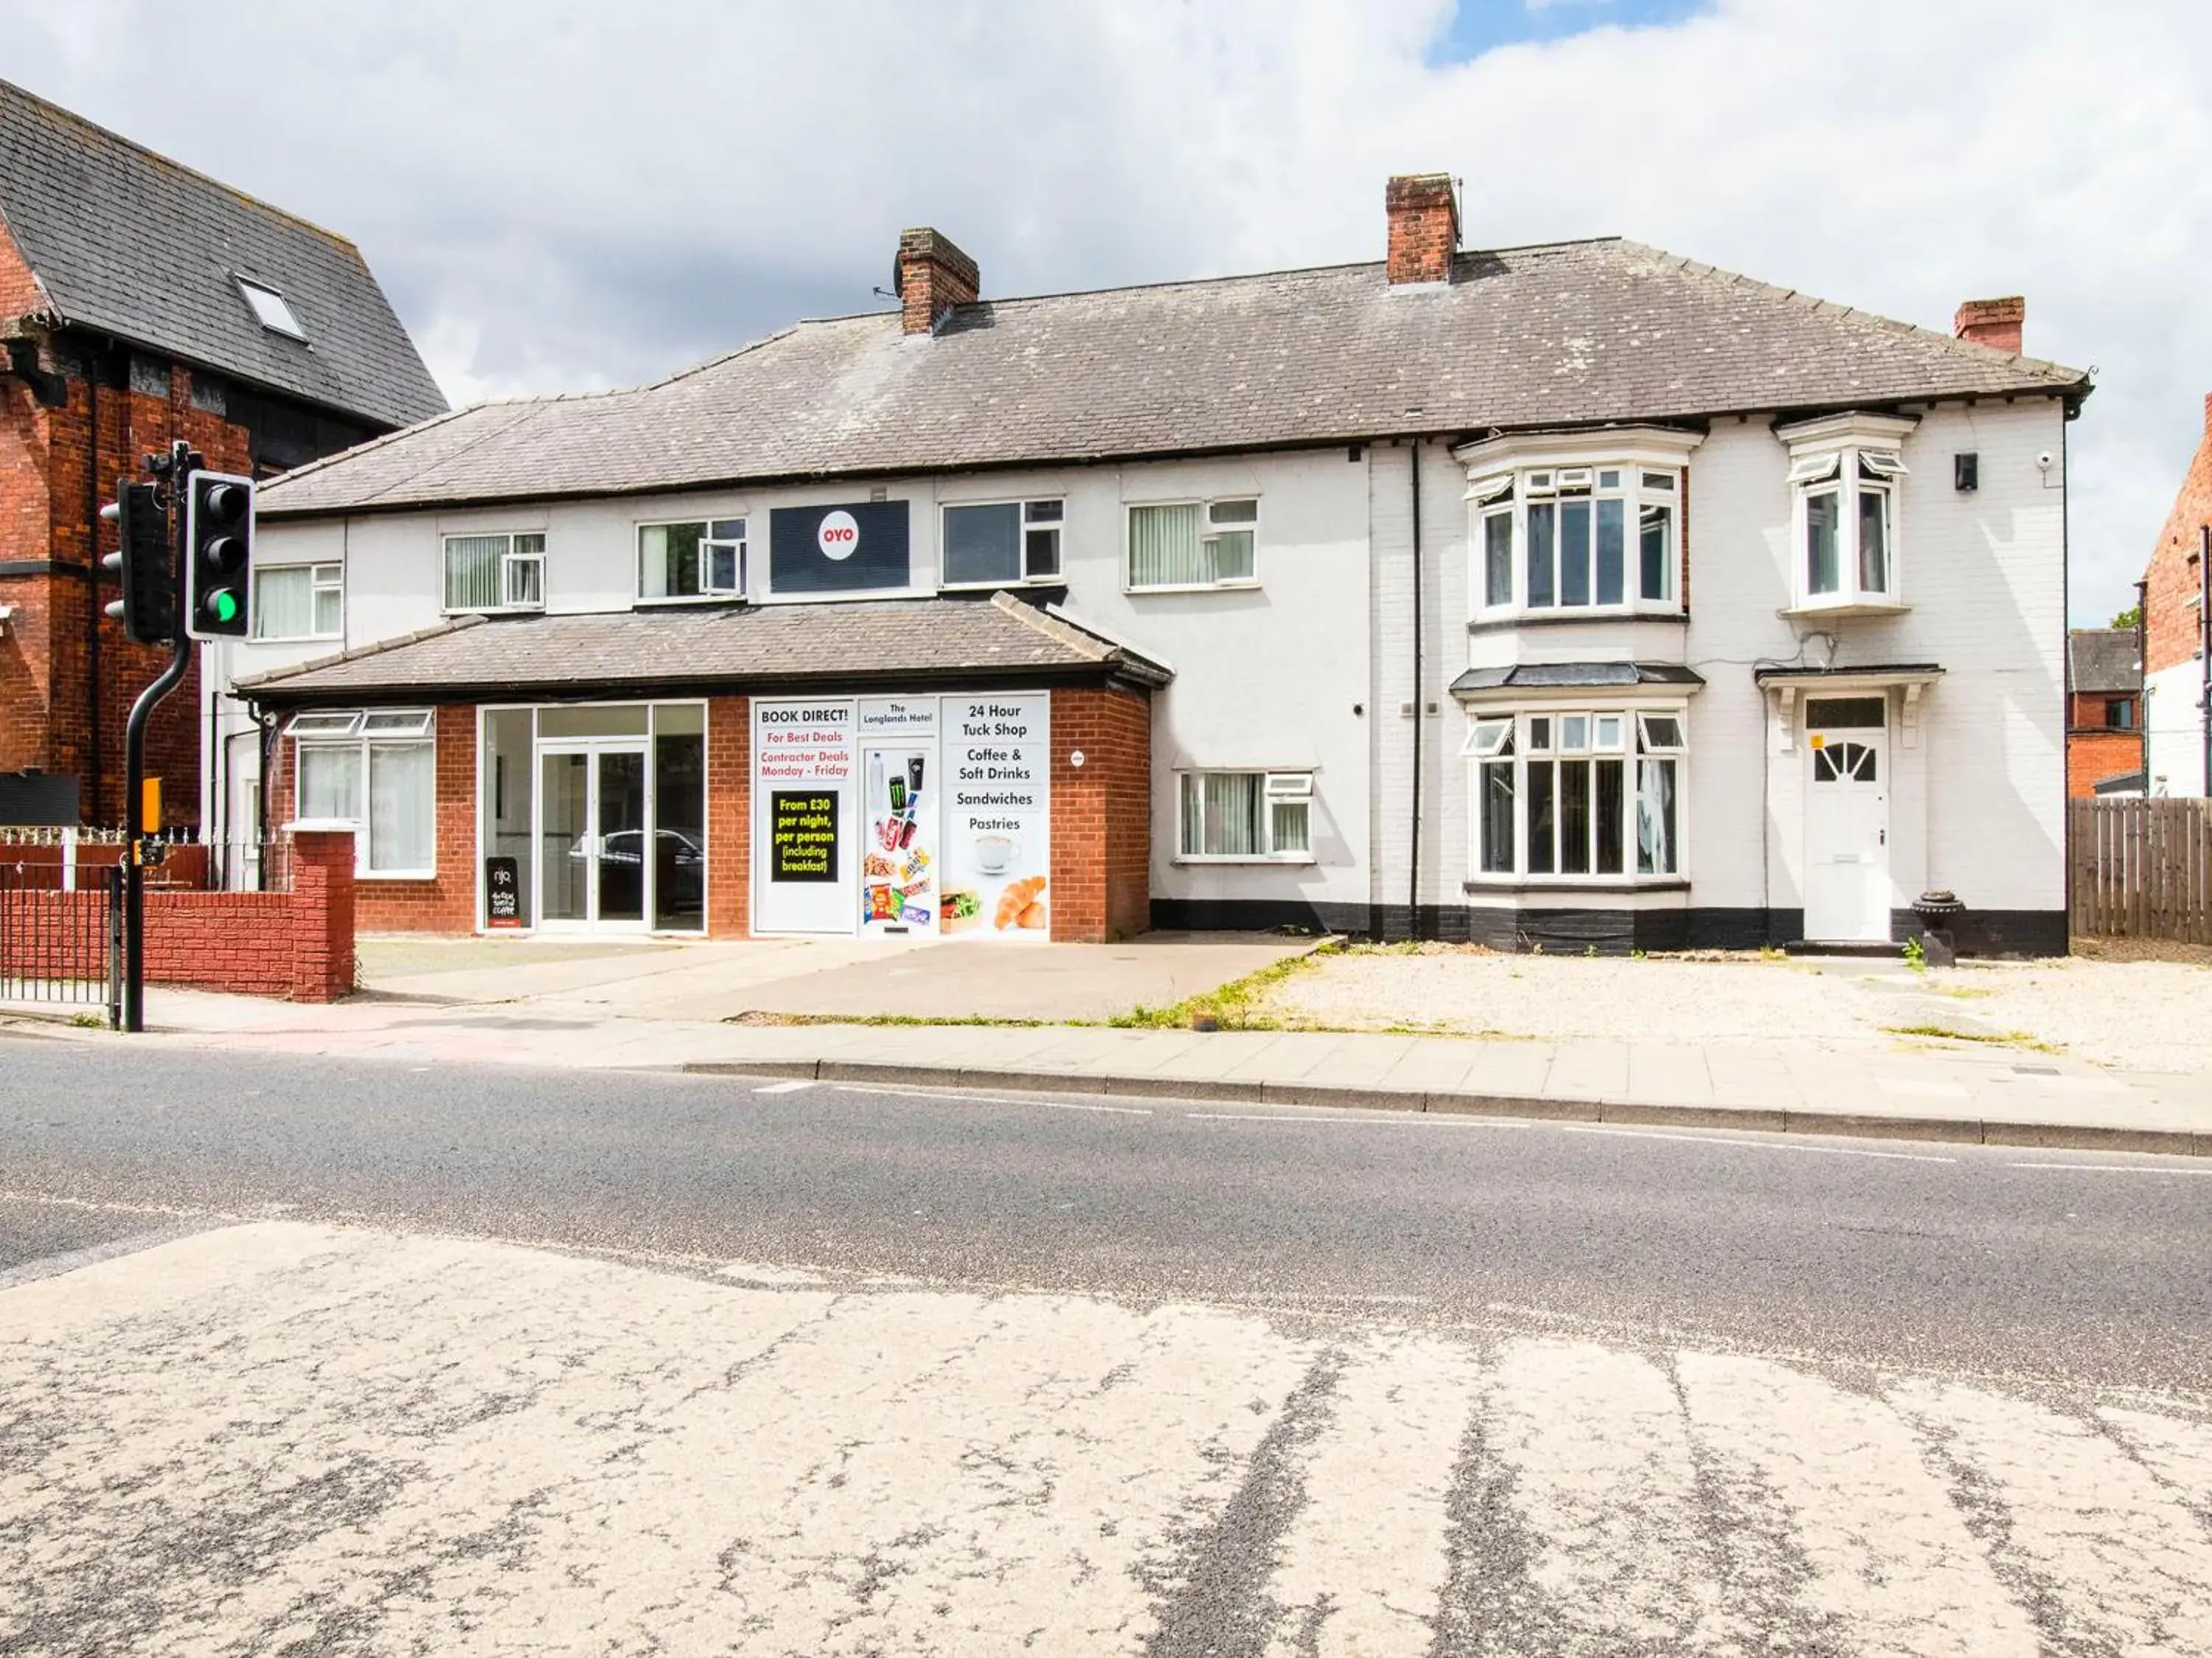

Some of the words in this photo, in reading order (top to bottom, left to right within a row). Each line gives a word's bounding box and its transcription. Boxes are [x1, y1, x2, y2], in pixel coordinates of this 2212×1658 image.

[824, 529, 853, 542] OYO
[891, 704, 905, 712] The
[969, 705, 984, 717] 24
[989, 704, 1021, 717] Hour
[762, 710, 799, 722] BOOK
[802, 709, 849, 721] DIRECT!
[863, 714, 907, 725] Longlands
[909, 713, 933, 722] Hotel
[768, 732, 785, 743] For
[787, 732, 810, 743] Best
[813, 731, 843, 742] Deals
[962, 723, 990, 735] Tuck
[995, 723, 1027, 738] Shop
[761, 752, 815, 762] Contractor
[819, 751, 849, 761] Deals
[967, 749, 1008, 760] Coffee
[1012, 749, 1021, 760] &
[762, 766, 804, 777] Monday
[815, 764, 849, 777] Friday
[959, 766, 983, 779] Soft
[988, 766, 1030, 780] Drinks
[779, 799, 807, 811] From
[810, 799, 831, 811] £30
[957, 792, 1033, 805] Sandwiches
[779, 816, 797, 828] per
[799, 814, 832, 828] night,
[970, 817, 1020, 830] Pastries
[776, 833, 795, 844] per
[797, 833, 835, 844] person
[782, 845, 827, 859] (including
[782, 859, 827, 873] breakfast)
